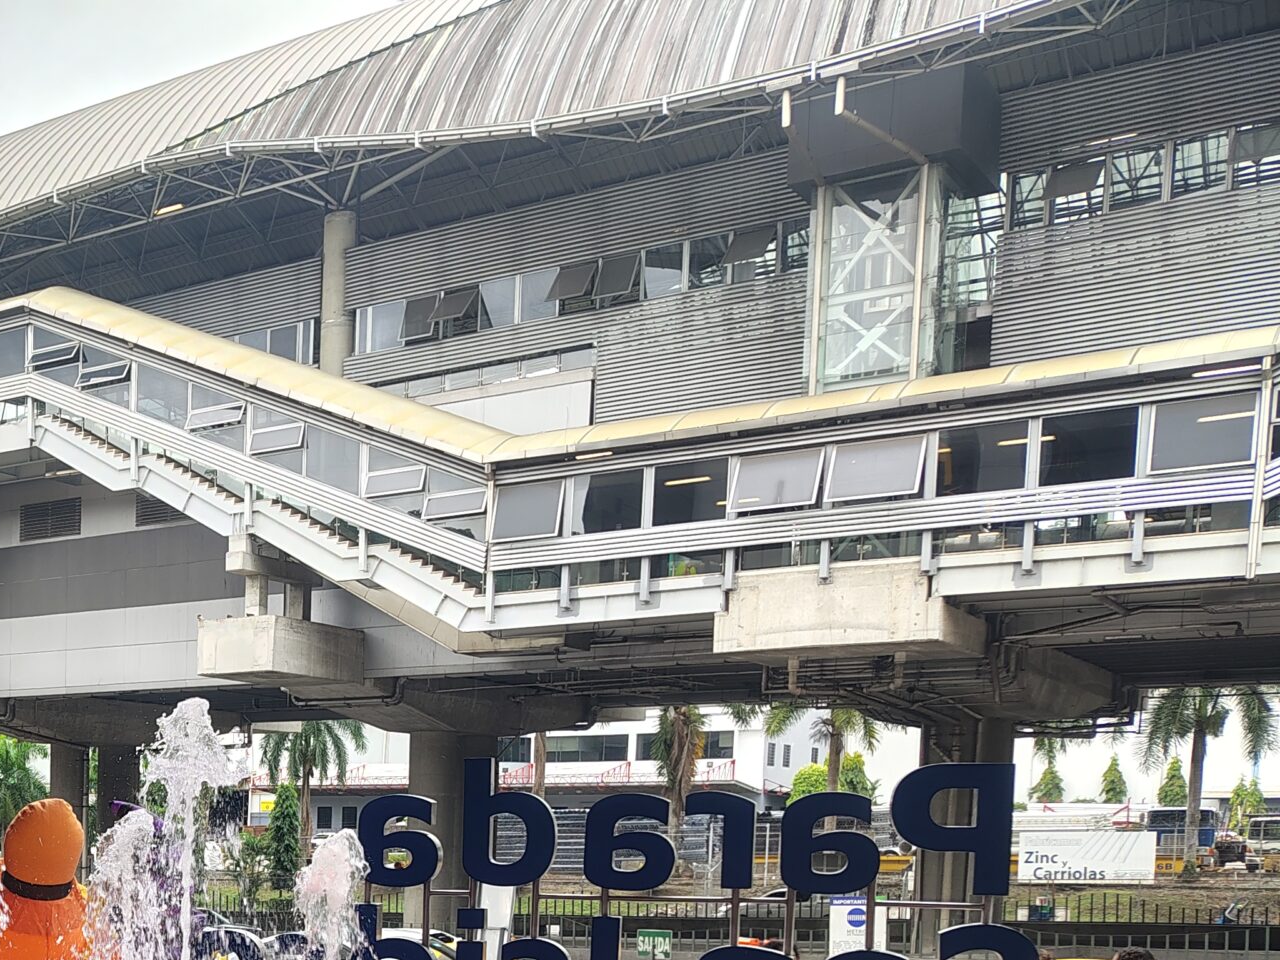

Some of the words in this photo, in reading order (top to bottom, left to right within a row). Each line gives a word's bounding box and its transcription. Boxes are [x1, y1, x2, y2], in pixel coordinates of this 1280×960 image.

[1024, 851, 1059, 864] Zinc
[1061, 860, 1069, 869] y
[1032, 866, 1107, 881] Carriolas
[637, 936, 670, 953] SALIDA
